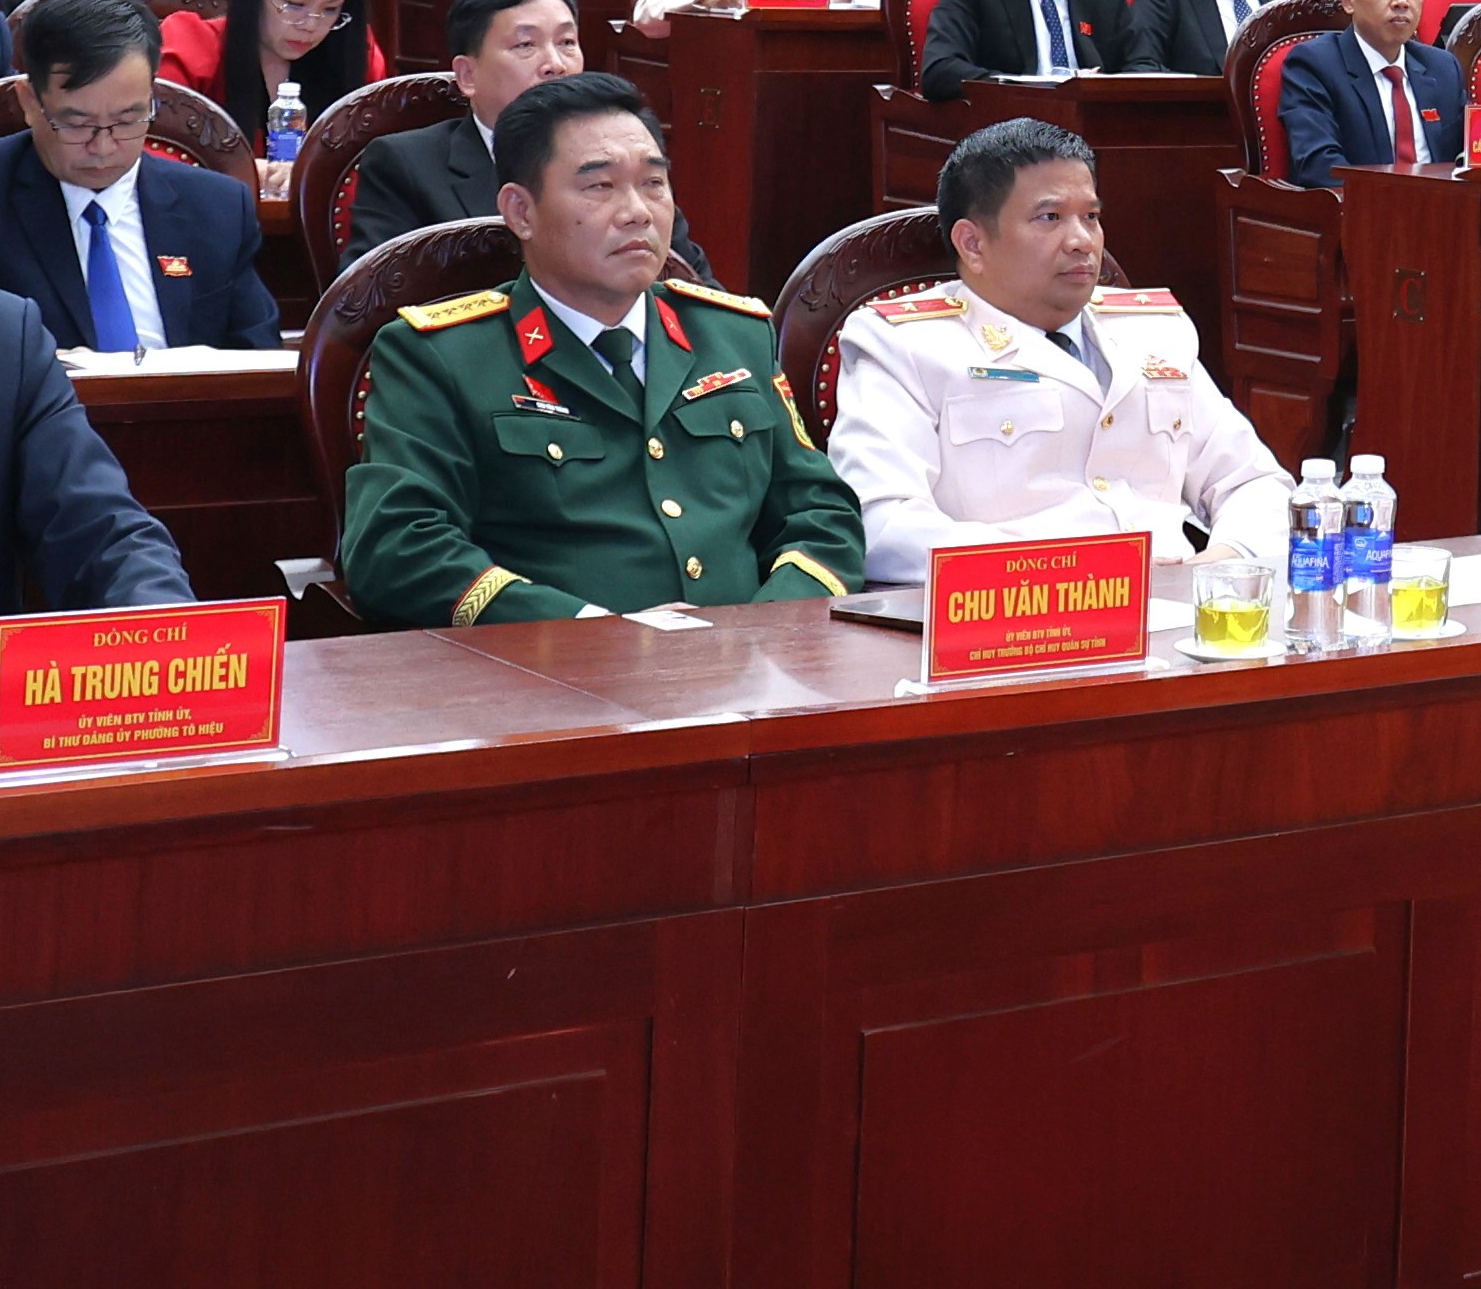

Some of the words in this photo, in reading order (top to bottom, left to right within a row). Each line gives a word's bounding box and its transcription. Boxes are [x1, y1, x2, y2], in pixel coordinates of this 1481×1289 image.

[1005, 555, 1048, 573] ĐỒNG
[1050, 551, 1078, 570] CHÍ
[947, 589, 996, 624] CHU
[1002, 579, 1050, 619] VĂN
[1055, 573, 1131, 614] THÀNH
[93, 626, 149, 648] ĐỒNG
[152, 621, 189, 643] CHÍ
[24, 660, 63, 707] HÀ
[70, 661, 159, 703] TRUNG
[167, 642, 249, 695] CHIẾN
[78, 715, 94, 729] ỦY
[96, 714, 121, 728] VIÊN
[124, 712, 146, 726] BTV
[147, 708, 174, 723] TỈNH
[43, 736, 56, 749] BÍ
[58, 734, 82, 748] THƯ
[82, 730, 114, 746] ĐẢNG
[116, 728, 131, 743] ỦY
[133, 725, 179, 742] PHƯỜNG
[182, 722, 196, 737] TÔ
[198, 721, 224, 738] HIỆU
